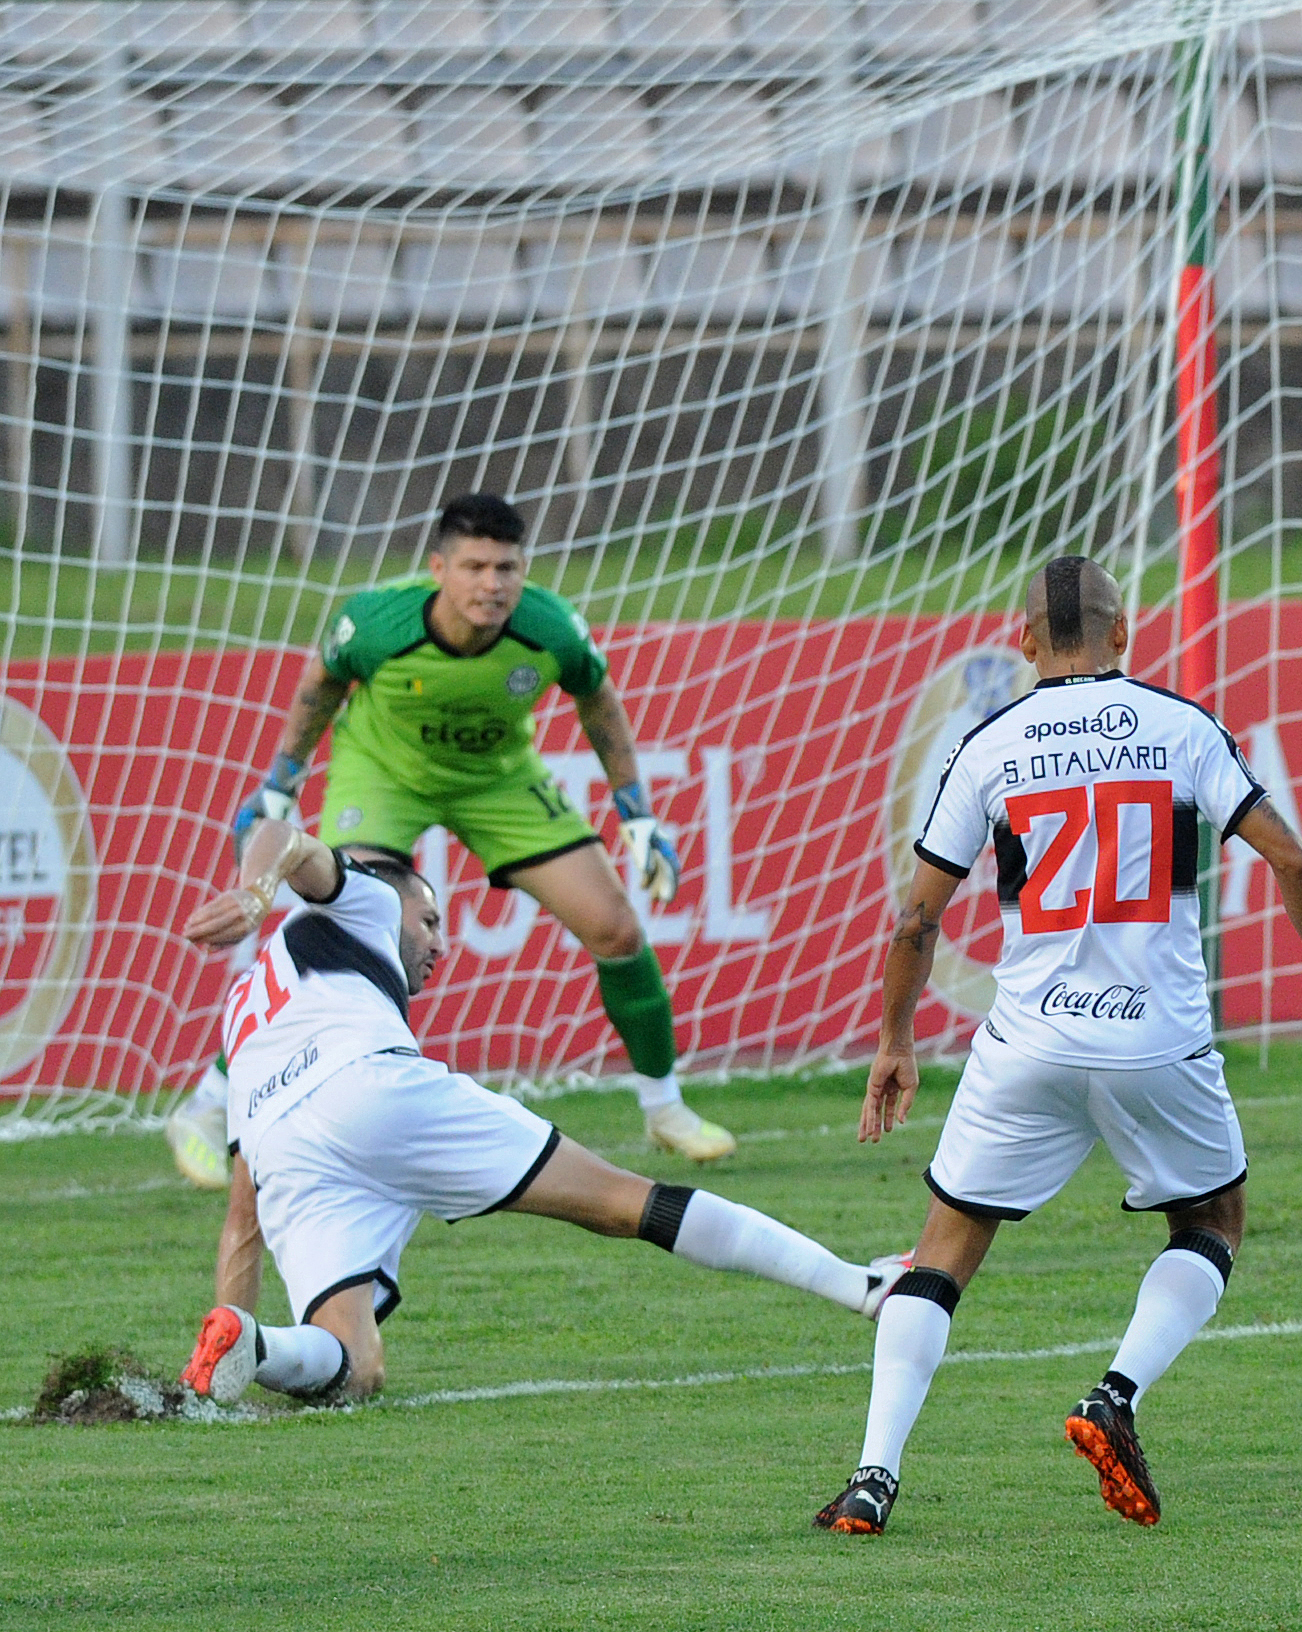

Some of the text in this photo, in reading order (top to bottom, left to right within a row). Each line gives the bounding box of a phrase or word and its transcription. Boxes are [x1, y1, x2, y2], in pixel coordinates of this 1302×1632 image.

[1031, 745, 1167, 780] OTALVARO
[1004, 780, 1173, 935] 20
[1040, 981, 1152, 1021] Coca-Cola
